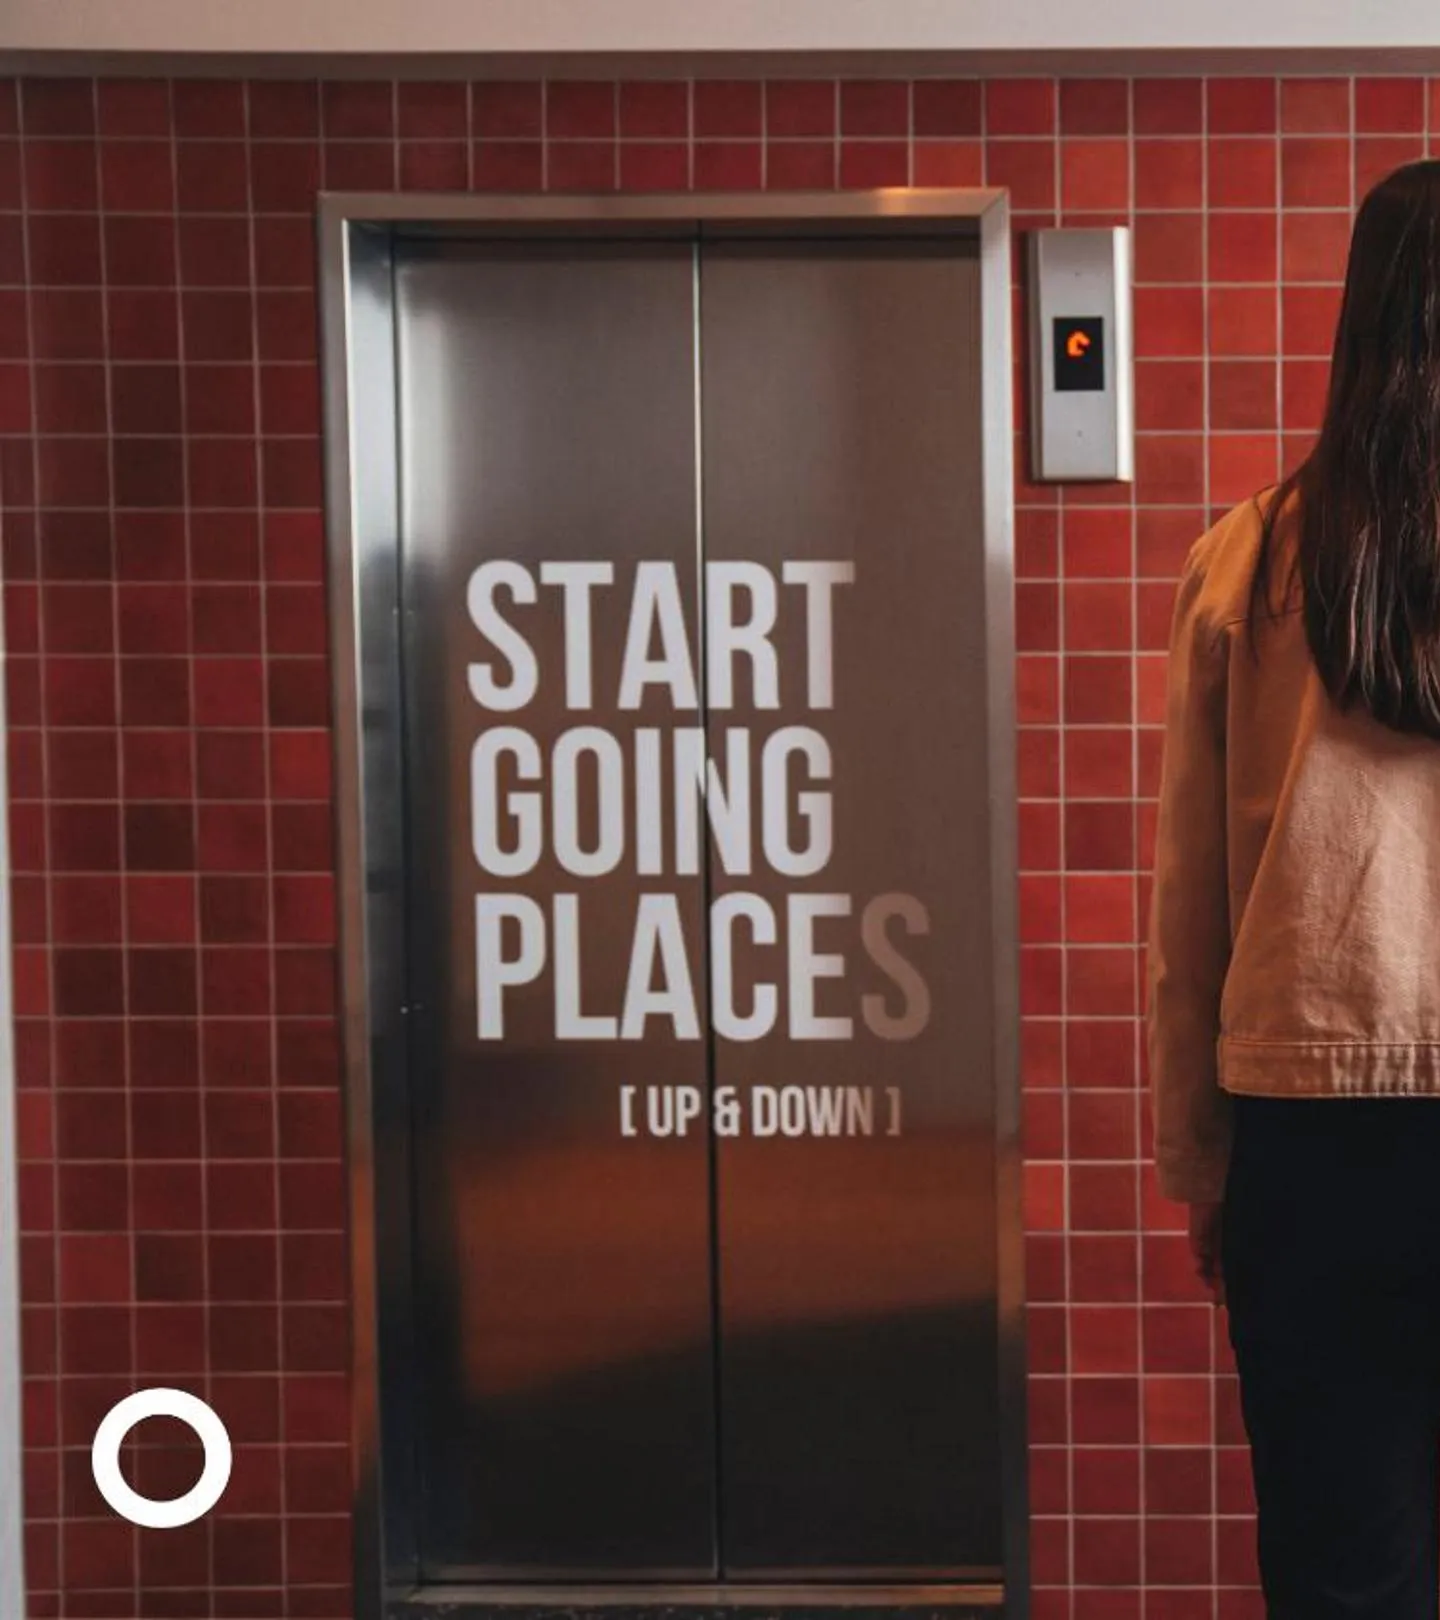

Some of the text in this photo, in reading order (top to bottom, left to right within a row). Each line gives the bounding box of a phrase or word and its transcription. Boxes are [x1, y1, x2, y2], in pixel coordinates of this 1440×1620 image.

[467, 559, 856, 712] START
[471, 726, 834, 877] GOING
[475, 892, 932, 1042] PLACES
[713, 1086, 741, 1137] &
